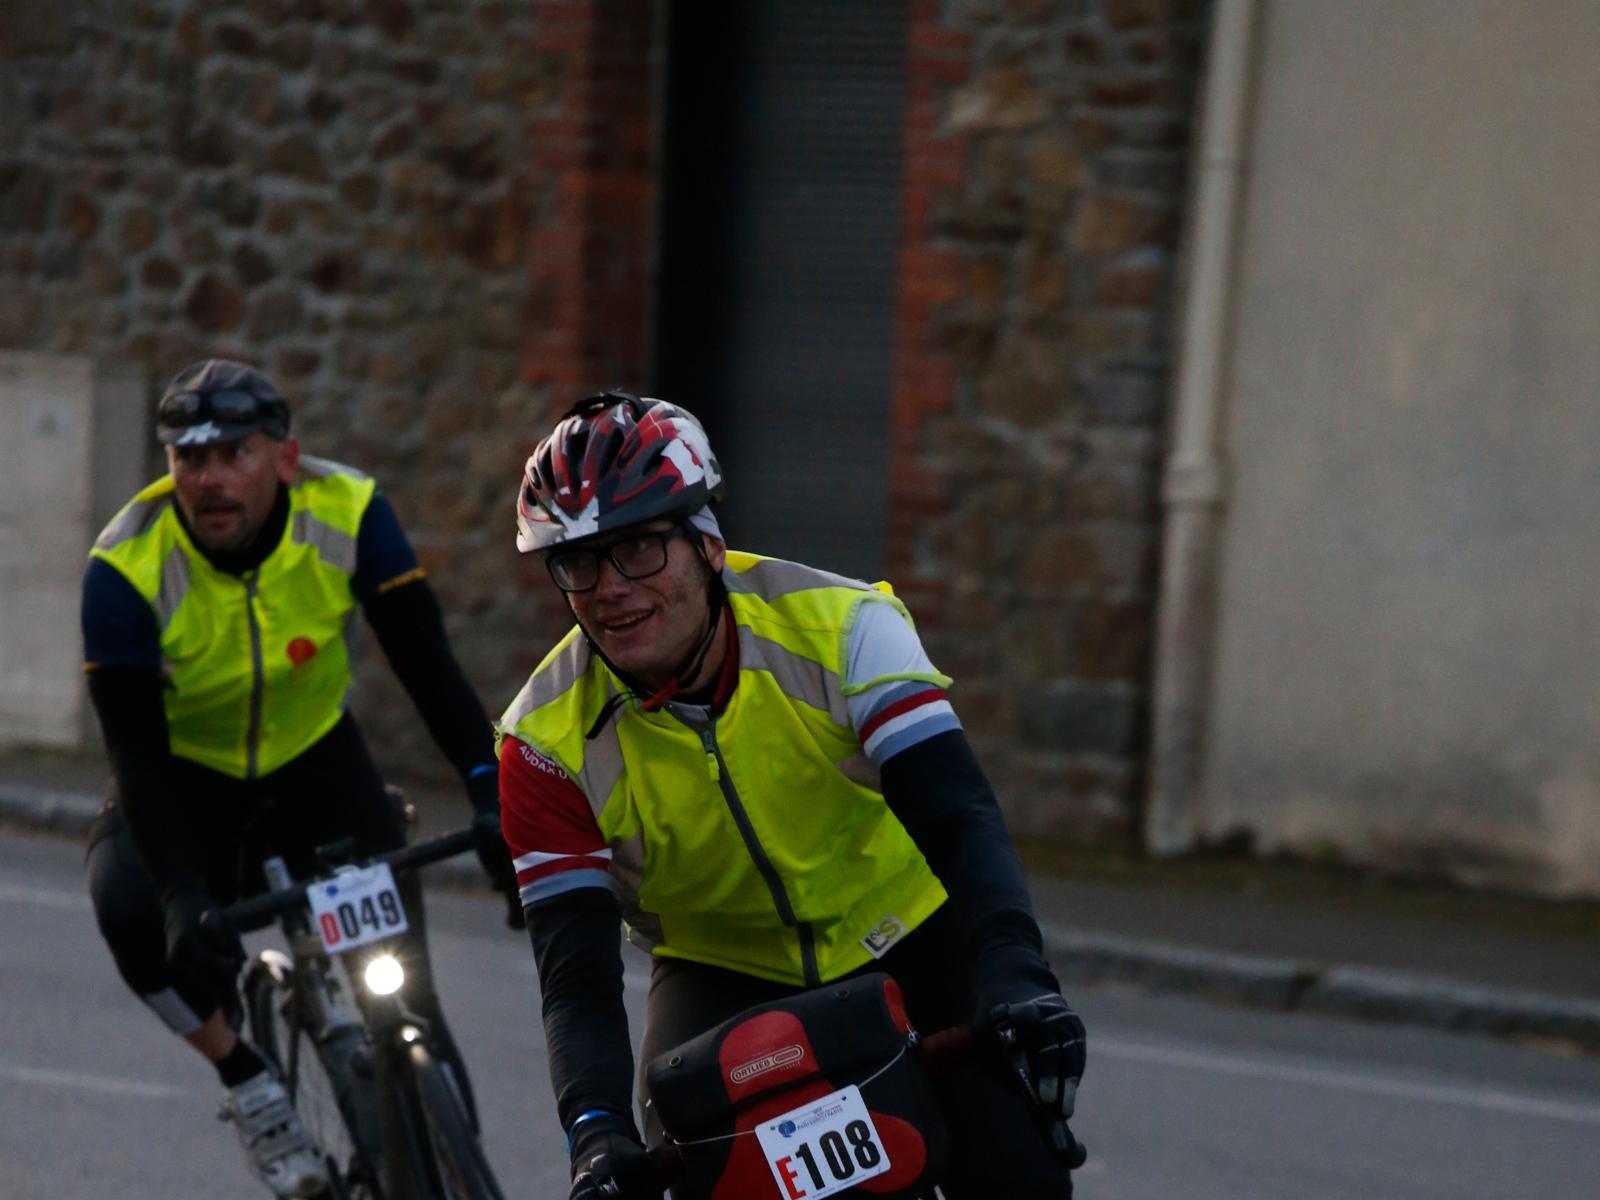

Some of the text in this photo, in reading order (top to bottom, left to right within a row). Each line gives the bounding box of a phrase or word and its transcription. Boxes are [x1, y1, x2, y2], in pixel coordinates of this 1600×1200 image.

[518, 744, 556, 777] AUDAX
[319, 889, 401, 945] D049
[735, 1058, 771, 1079] ORTLIEB
[775, 1119, 881, 1200] E108
